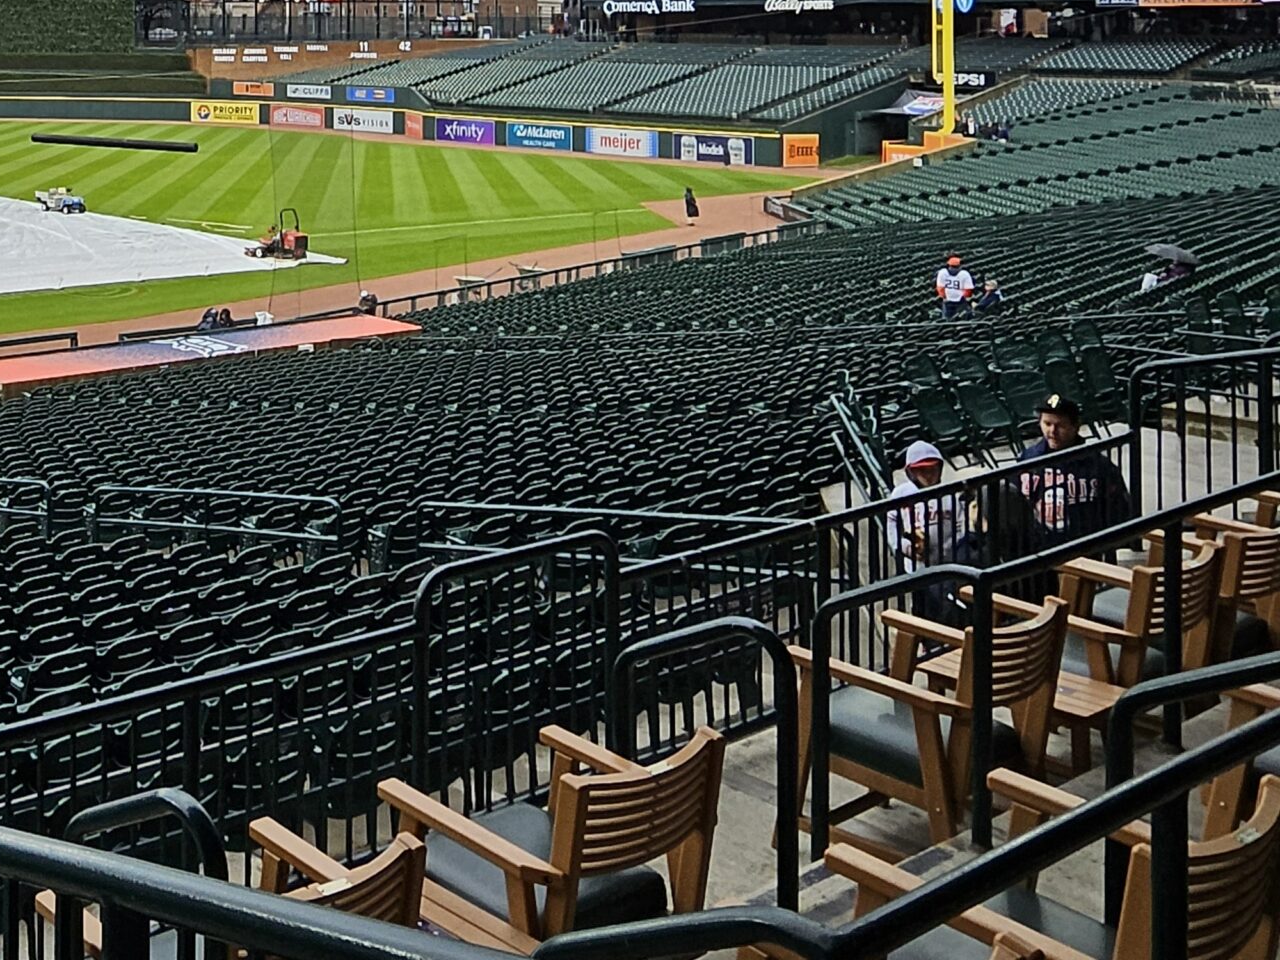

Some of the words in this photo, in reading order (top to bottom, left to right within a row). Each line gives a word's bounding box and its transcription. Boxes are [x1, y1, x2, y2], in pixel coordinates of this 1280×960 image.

[603, 0, 660, 15] Comerica
[802, 0, 834, 11] SPORTS
[358, 41, 369, 52] 11
[399, 41, 411, 51] 42
[946, 73, 985, 86] EPSI
[213, 105, 254, 115] PRIORITY
[363, 117, 390, 128] VISION
[444, 121, 484, 141] xfinity
[527, 126, 565, 139] McLaren
[600, 133, 641, 152] meijer
[945, 280, 960, 290] 29
